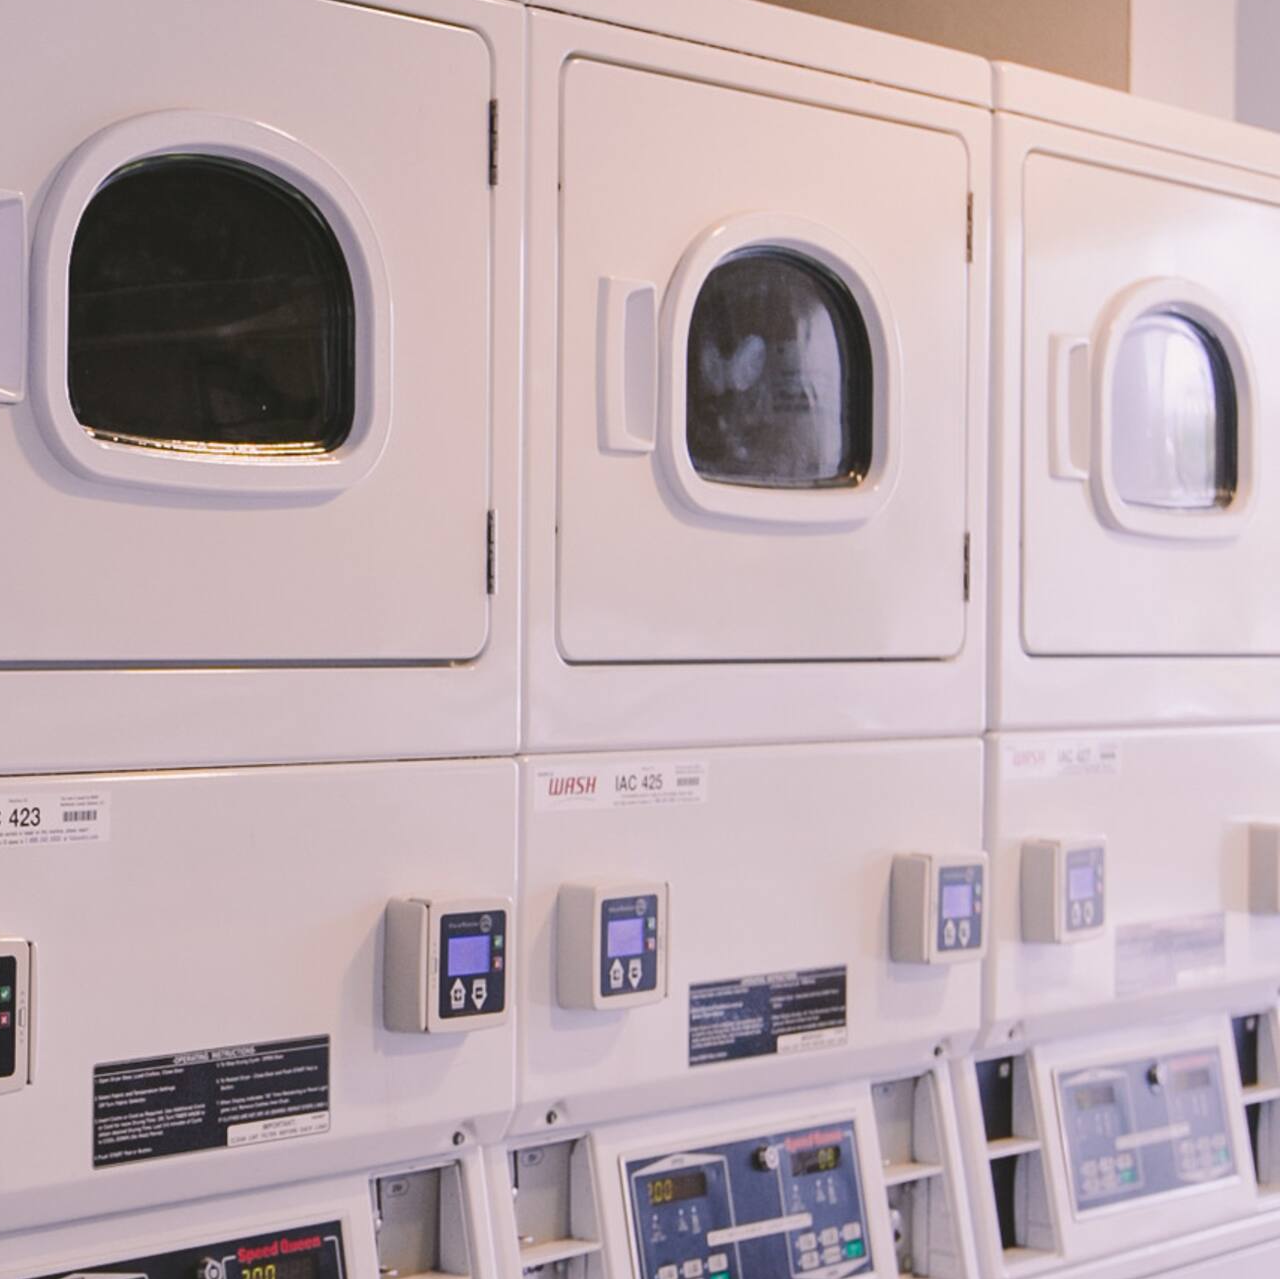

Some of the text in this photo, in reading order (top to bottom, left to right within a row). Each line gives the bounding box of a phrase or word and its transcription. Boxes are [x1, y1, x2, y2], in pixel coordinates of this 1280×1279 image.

[548, 776, 596, 796] WASH
[615, 775, 638, 792] IAC
[8, 807, 41, 828] 423
[237, 1235, 321, 1264] Speed Queen
